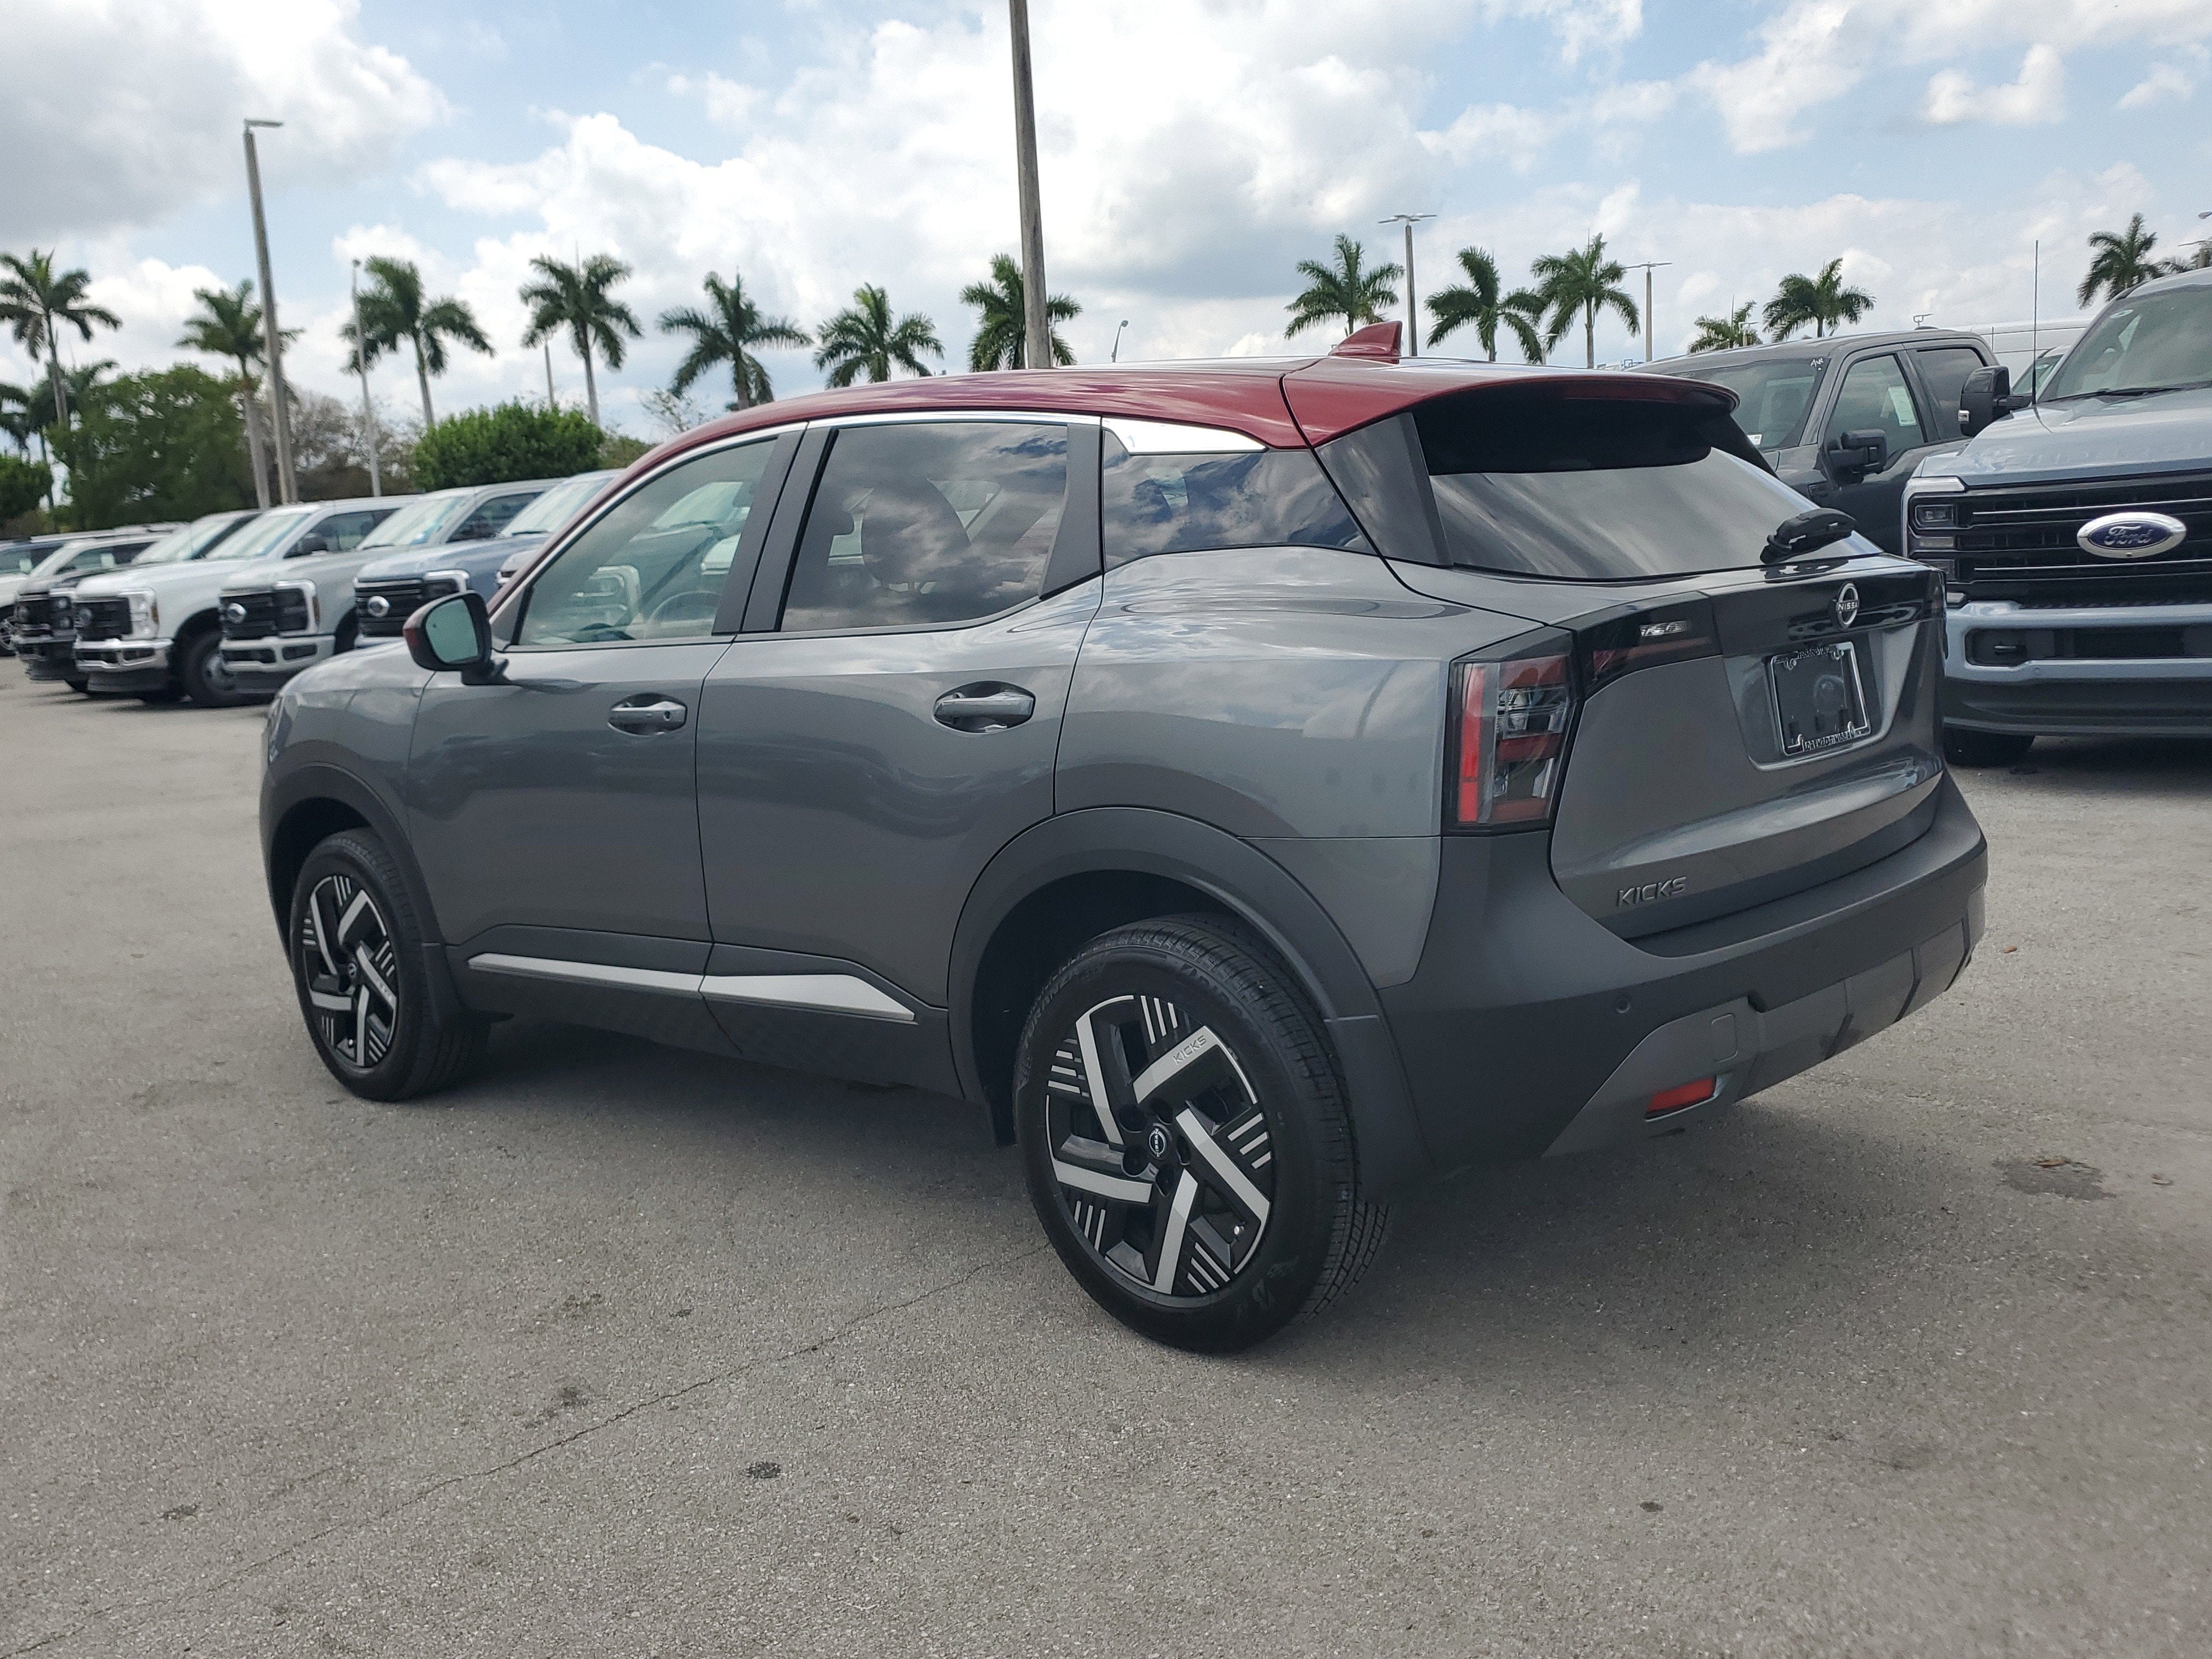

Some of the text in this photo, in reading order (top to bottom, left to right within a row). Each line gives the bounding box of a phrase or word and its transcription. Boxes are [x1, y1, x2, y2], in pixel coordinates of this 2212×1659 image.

[2104, 525, 2153, 546] Ford
[1617, 876, 1686, 906] KICKS
[1173, 1035, 1207, 1064] KICKS
